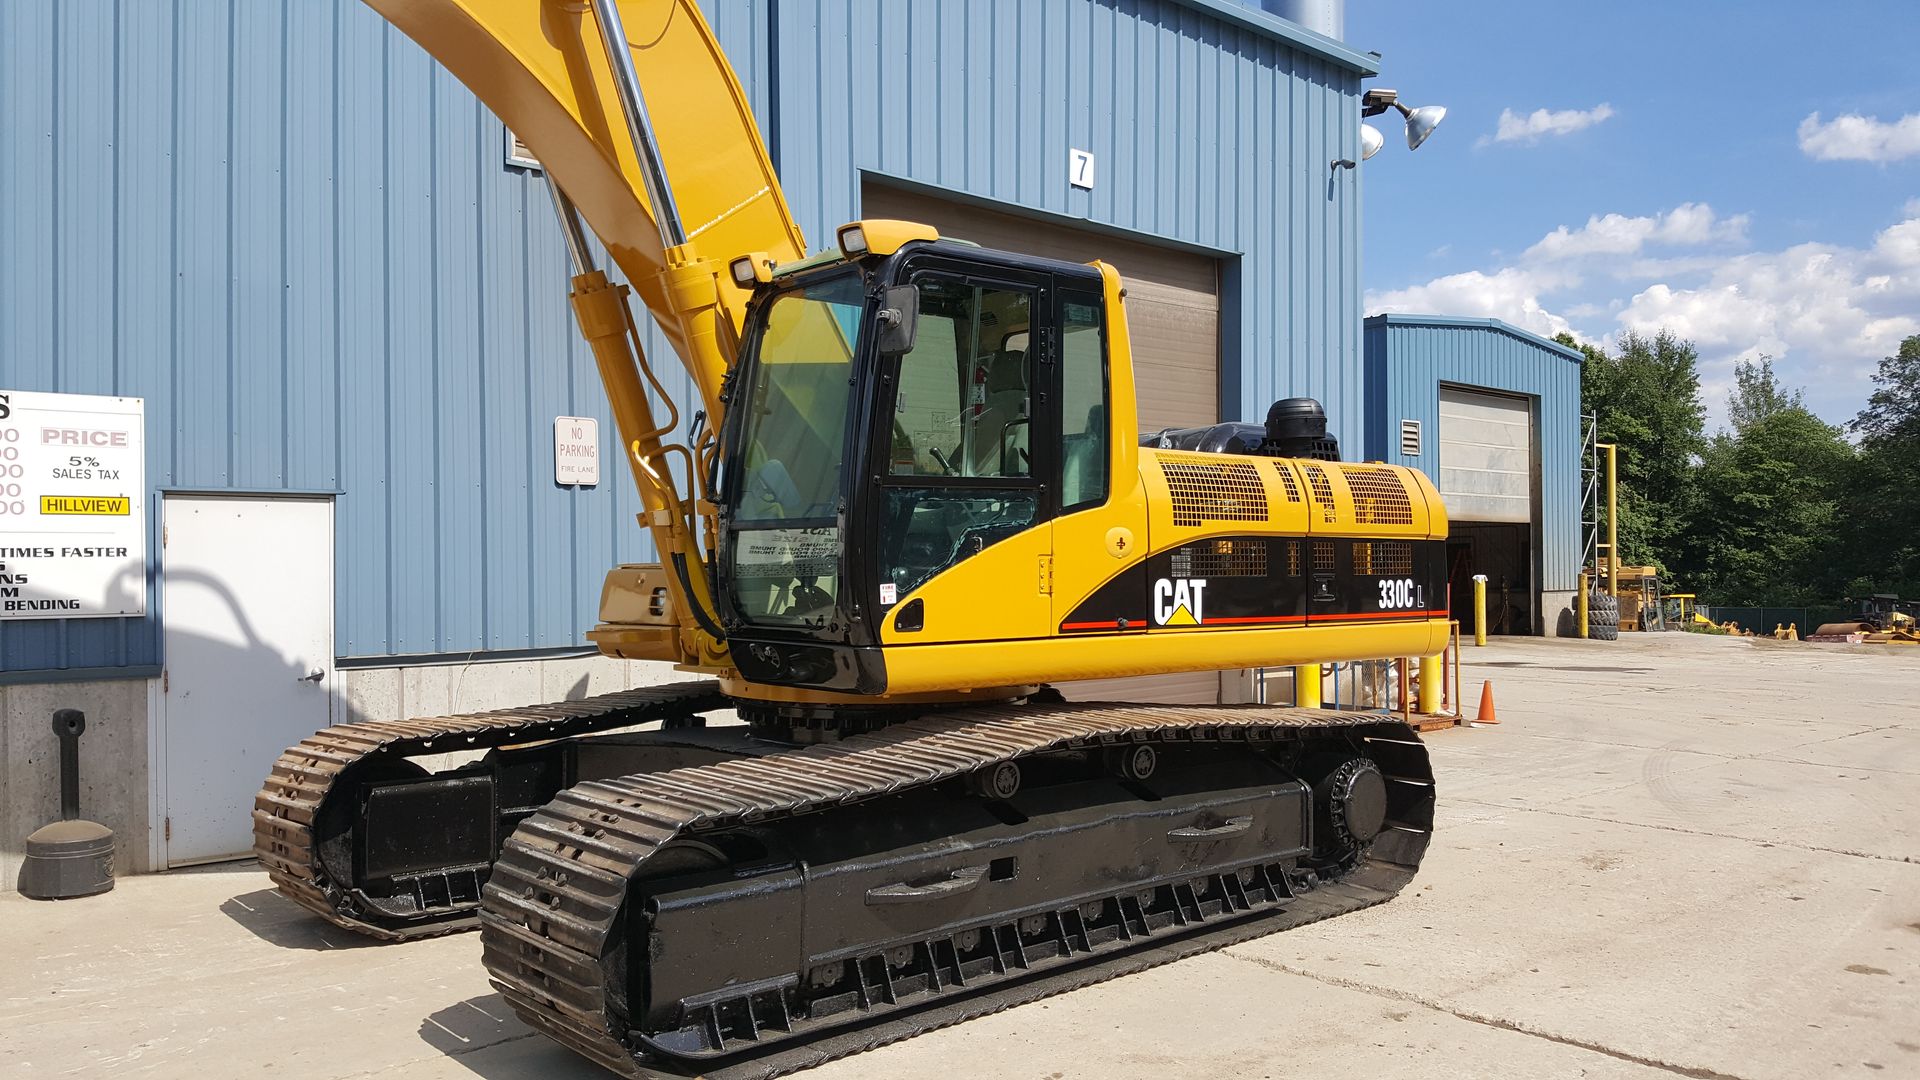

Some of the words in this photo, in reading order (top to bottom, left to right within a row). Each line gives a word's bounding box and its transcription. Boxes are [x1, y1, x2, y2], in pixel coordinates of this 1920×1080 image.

[1078, 154, 1087, 181] 7
[0, 428, 19, 442] 0
[42, 428, 127, 447] PRICE
[571, 427, 583, 440] NO
[560, 444, 595, 458] PARKING
[68, 456, 100, 467] 5%
[52, 468, 92, 480] SALES
[97, 469, 120, 480] TAX
[47, 499, 122, 512] HILLVIEW
[0, 547, 54, 558] TIMES
[61, 547, 127, 558] FASTER
[1378, 578, 1414, 609] 330C
[1416, 584, 1425, 608] L
[4, 599, 80, 611] BENDING
[1154, 578, 1206, 625] CAT
